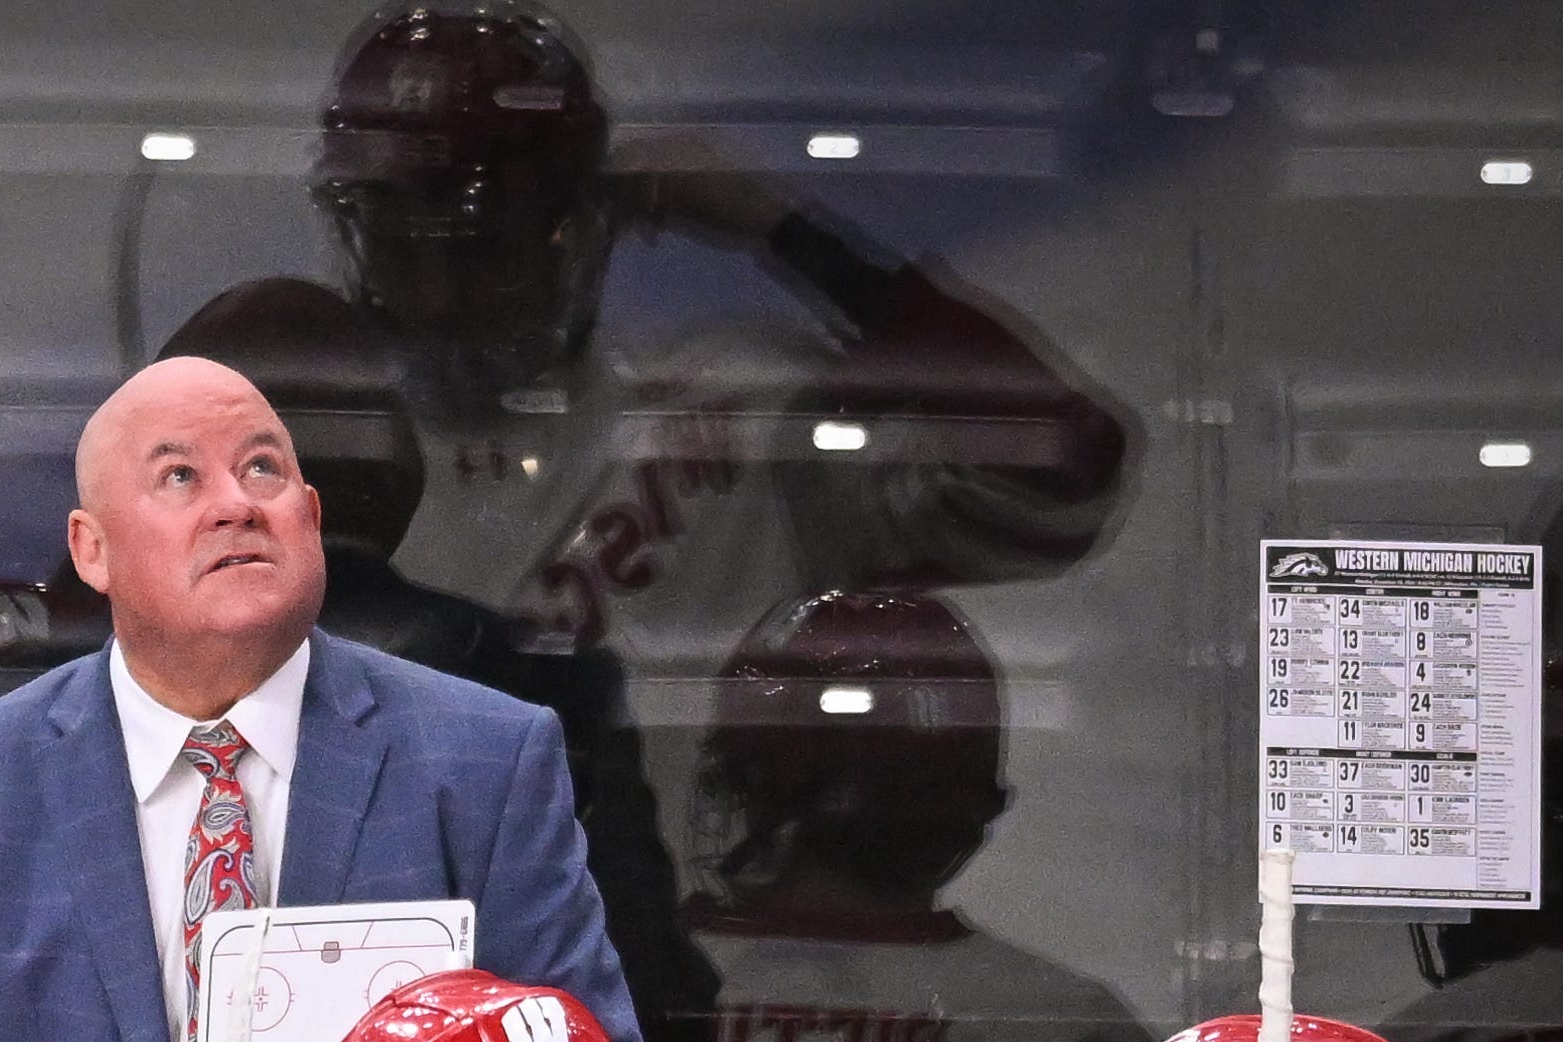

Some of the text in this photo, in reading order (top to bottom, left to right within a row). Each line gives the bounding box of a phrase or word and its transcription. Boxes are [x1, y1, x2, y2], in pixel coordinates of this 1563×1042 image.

[1335, 549, 1531, 575] WESTERN MICHIGAN HOCKEY
[1271, 598, 1288, 617] 17
[1340, 599, 1361, 619] 34
[1414, 601, 1430, 621] 18
[1269, 628, 1290, 647] 23
[1343, 630, 1358, 649] 13
[1416, 632, 1426, 651] 8
[1271, 658, 1288, 678] 19
[1340, 660, 1360, 680] 22
[1416, 662, 1426, 682] 4
[1269, 688, 1289, 708] 26
[1341, 691, 1359, 711] 21
[1410, 692, 1431, 713] 24
[1344, 721, 1356, 741] 11
[1416, 723, 1426, 743] 9
[1268, 760, 1288, 779] 33
[1339, 762, 1359, 782] 37
[1410, 764, 1430, 784] 30
[1270, 791, 1286, 811] 10
[1344, 794, 1354, 813] 3
[1417, 796, 1424, 816] 1
[1272, 824, 1283, 844] 6
[1340, 826, 1357, 846] 14
[1409, 828, 1431, 848] 35
